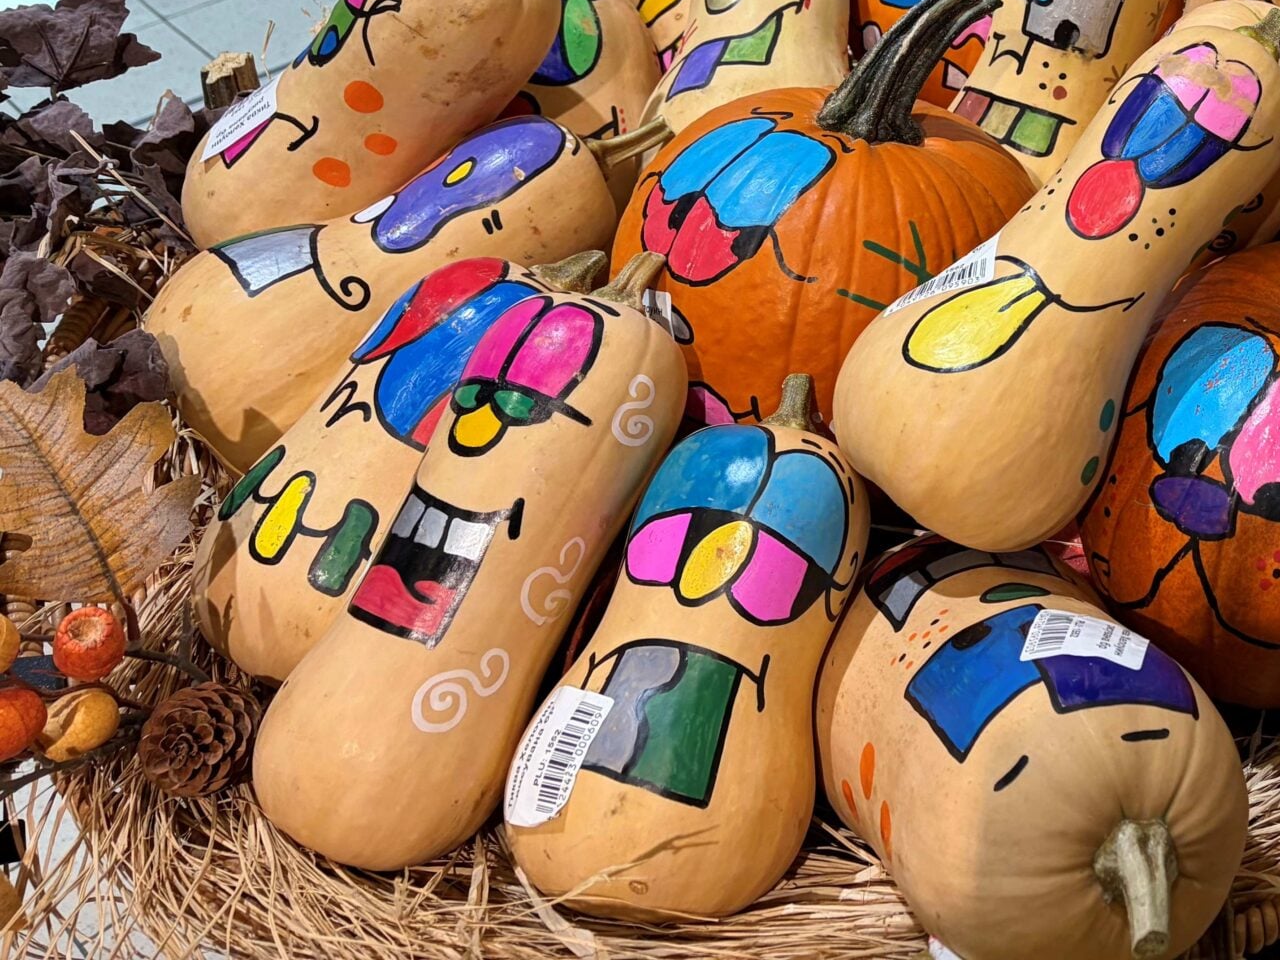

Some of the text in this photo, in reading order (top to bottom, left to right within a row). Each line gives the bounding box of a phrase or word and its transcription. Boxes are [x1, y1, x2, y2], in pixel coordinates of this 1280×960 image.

[520, 701, 555, 761] Хелоуин
[575, 712, 604, 757] 000609
[533, 758, 548, 787] PLU:
